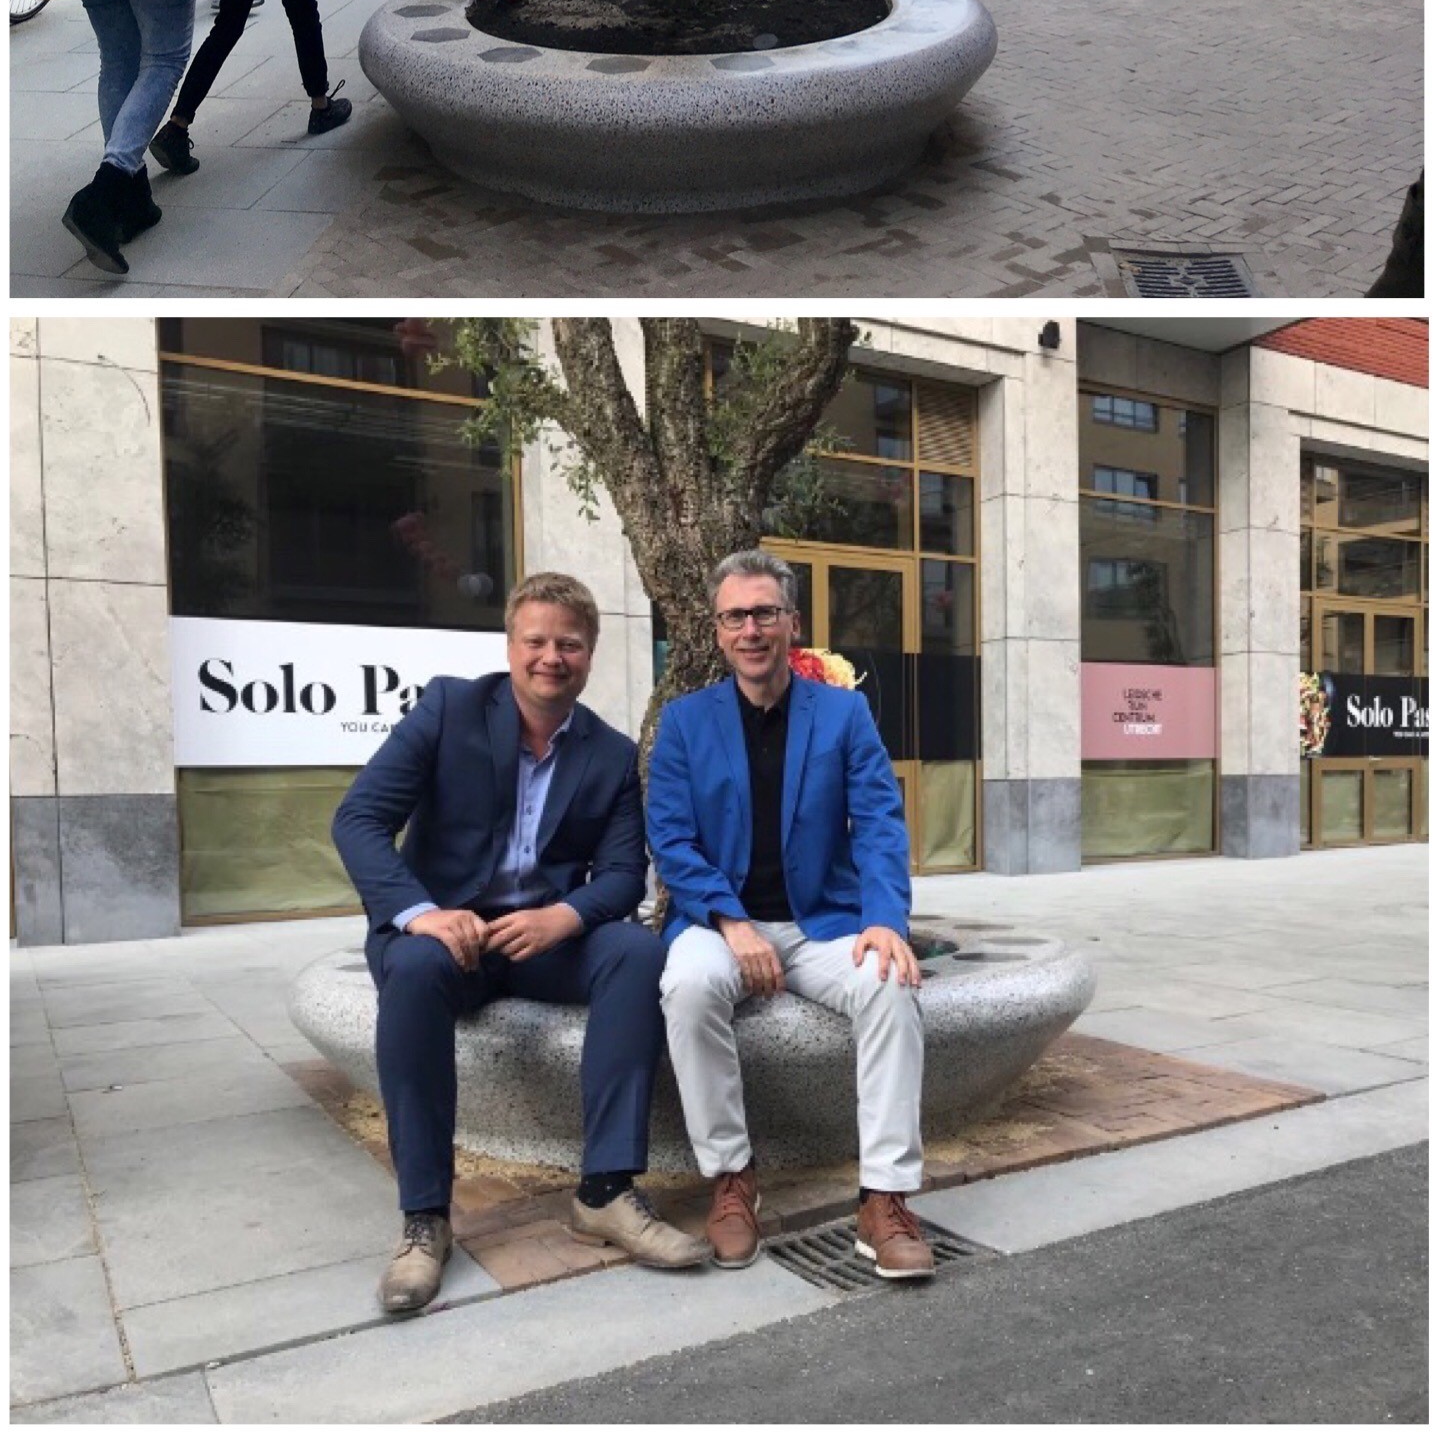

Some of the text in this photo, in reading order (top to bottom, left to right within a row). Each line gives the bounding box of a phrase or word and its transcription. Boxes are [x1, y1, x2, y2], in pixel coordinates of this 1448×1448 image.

[198, 658, 337, 715] Solo
[341, 722, 367, 732] YOU
[1347, 694, 1393, 727] Solo
